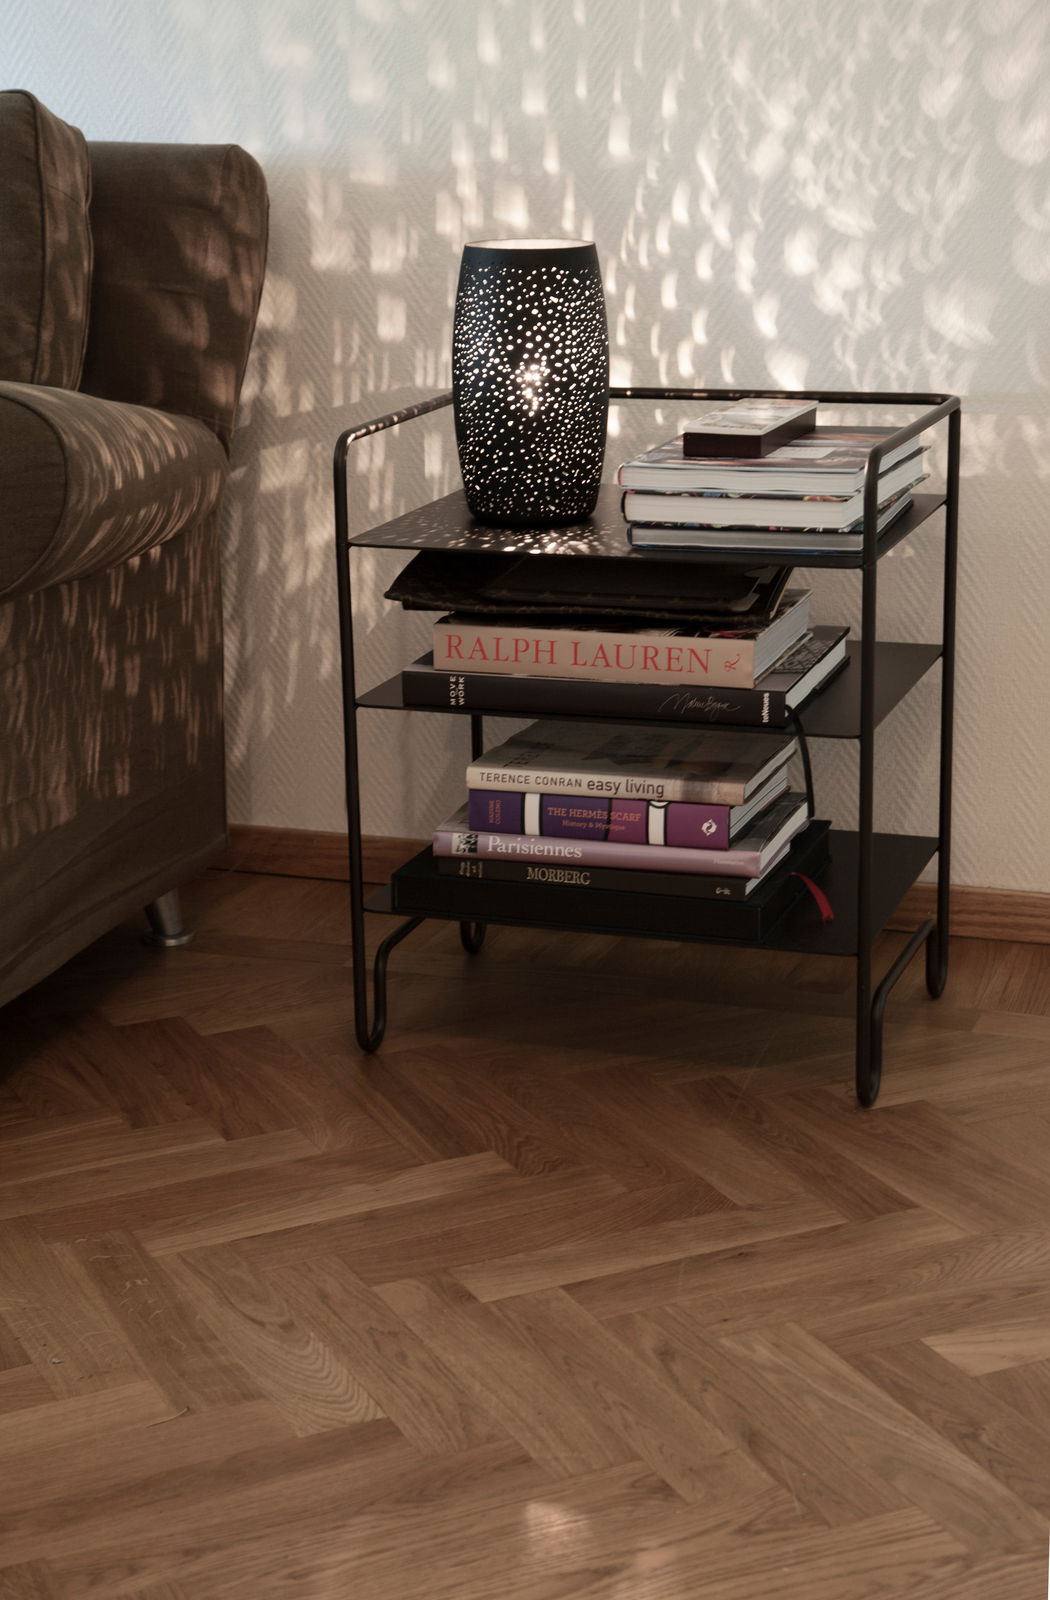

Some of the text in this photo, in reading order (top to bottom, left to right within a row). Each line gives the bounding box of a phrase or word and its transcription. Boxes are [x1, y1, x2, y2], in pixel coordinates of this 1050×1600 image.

[445, 634, 712, 673] RALPH LAUREN
[449, 675, 457, 706] MOVE
[480, 772, 665, 799] TERENCE CONRAN easy living
[547, 807, 568, 817] THE
[609, 811, 641, 822] SCARF
[488, 835, 582, 858] Parisiennes
[526, 867, 592, 885] MORBERG
